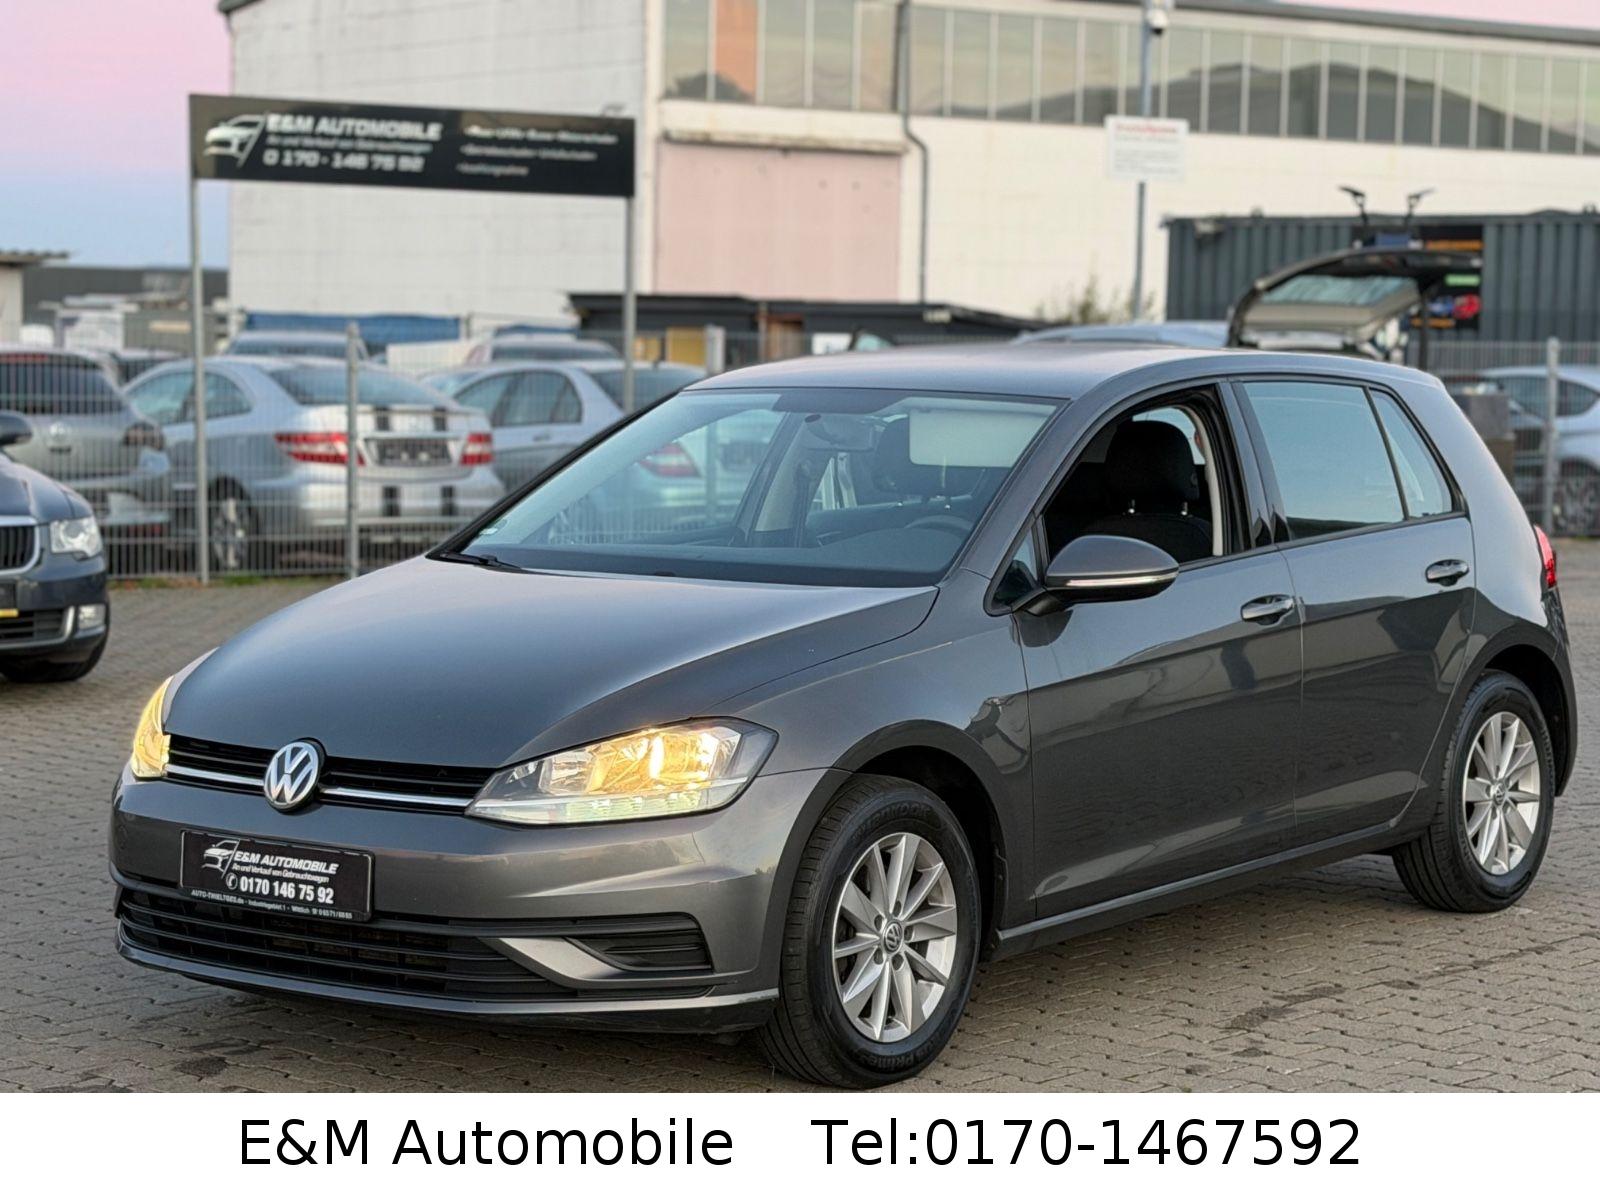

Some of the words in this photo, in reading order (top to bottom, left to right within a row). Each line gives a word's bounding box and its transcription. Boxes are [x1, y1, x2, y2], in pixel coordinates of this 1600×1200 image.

[266, 113, 315, 134] E&M
[314, 117, 443, 141] AUTOMOBILE
[234, 850, 261, 864] E&M
[260, 855, 339, 874] AUTOMOBILE
[240, 876, 270, 895] 0170
[273, 880, 296, 899] 146
[298, 884, 315, 901] 75
[317, 887, 334, 904] 92
